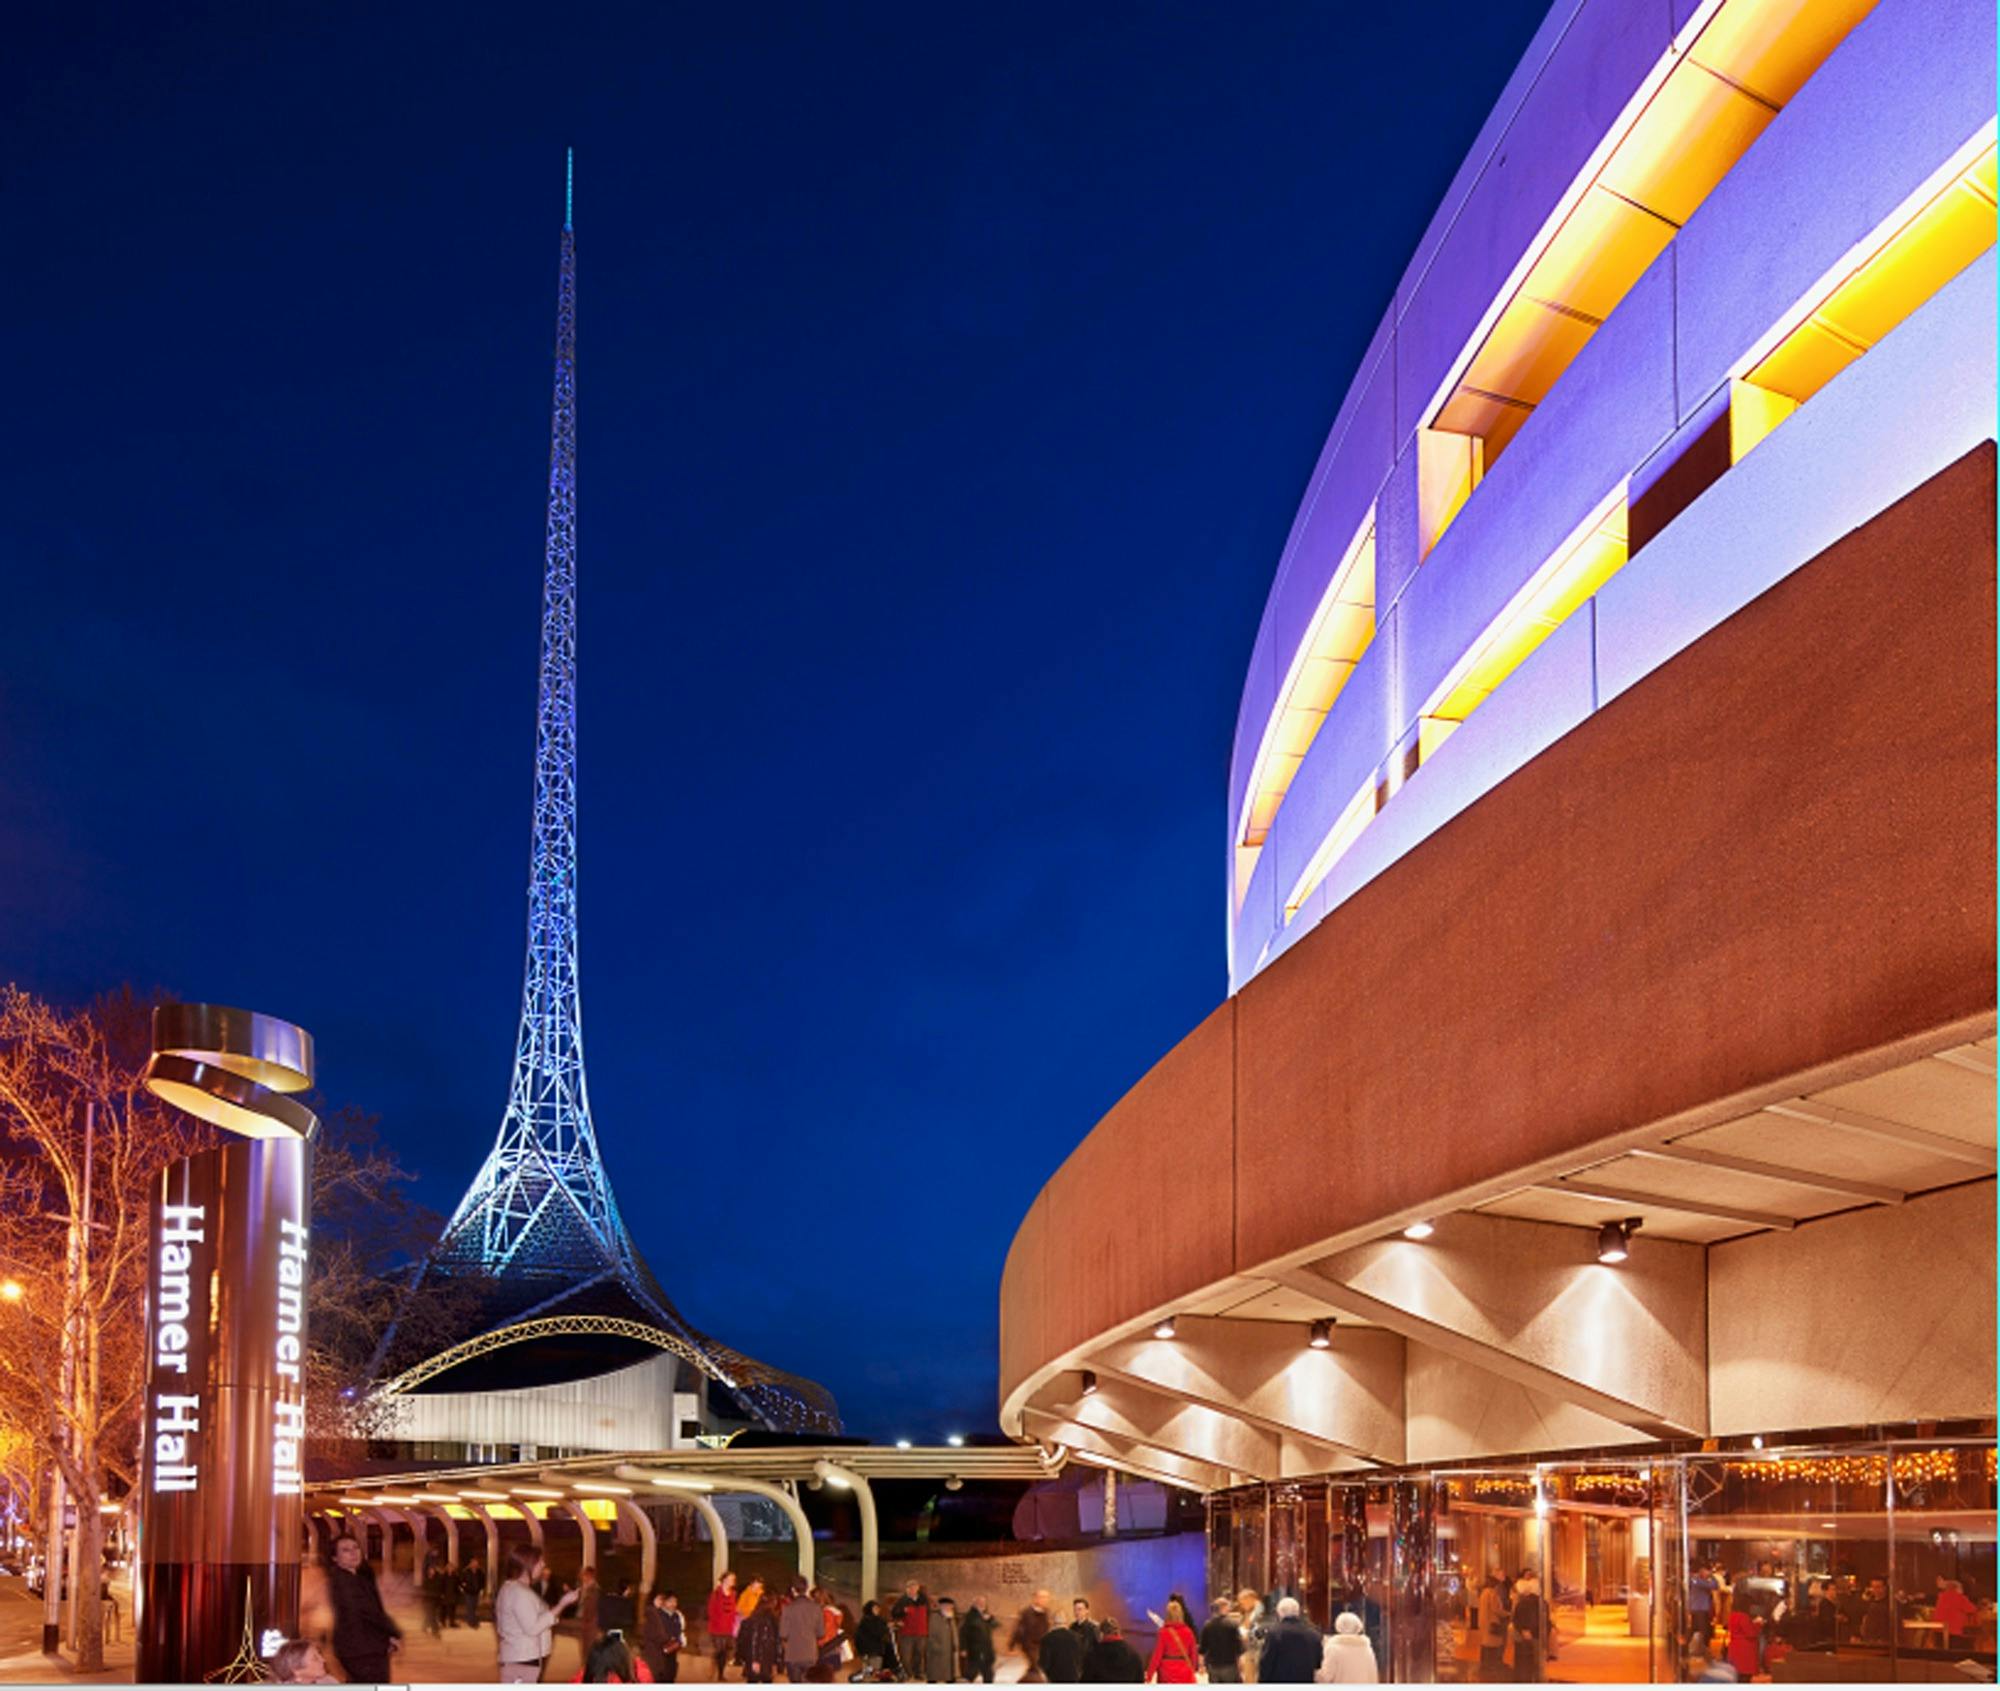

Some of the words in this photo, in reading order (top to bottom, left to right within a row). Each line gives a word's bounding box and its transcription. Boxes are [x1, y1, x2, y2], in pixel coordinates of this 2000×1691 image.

[158, 1203, 205, 1374] Hamer
[275, 1218, 309, 1383] Hamer
[154, 1394, 200, 1493] Hall
[272, 1394, 305, 1496] Hall
